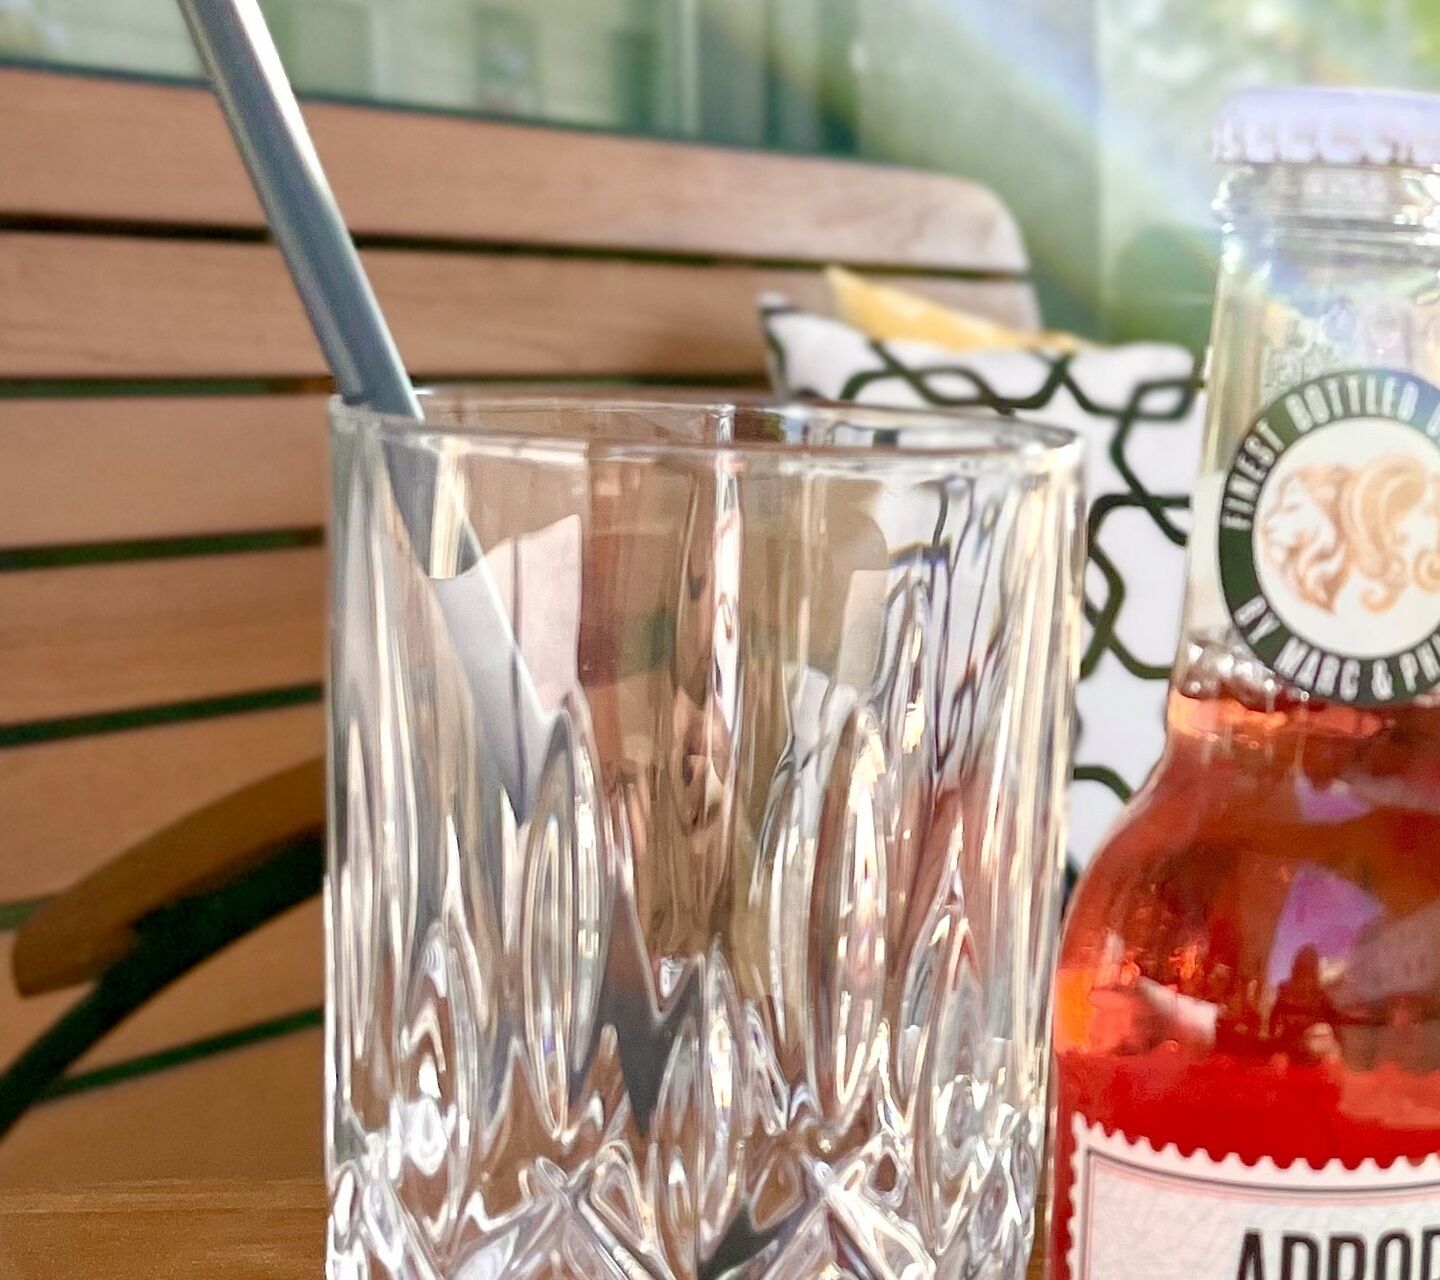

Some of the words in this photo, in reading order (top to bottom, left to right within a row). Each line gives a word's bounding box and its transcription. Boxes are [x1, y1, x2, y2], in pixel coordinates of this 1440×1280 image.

[1220, 419, 1284, 531] FINEST
[1285, 374, 1420, 434] BOTTLED
[1272, 636, 1361, 702] MARC
[1371, 658, 1394, 702] &
